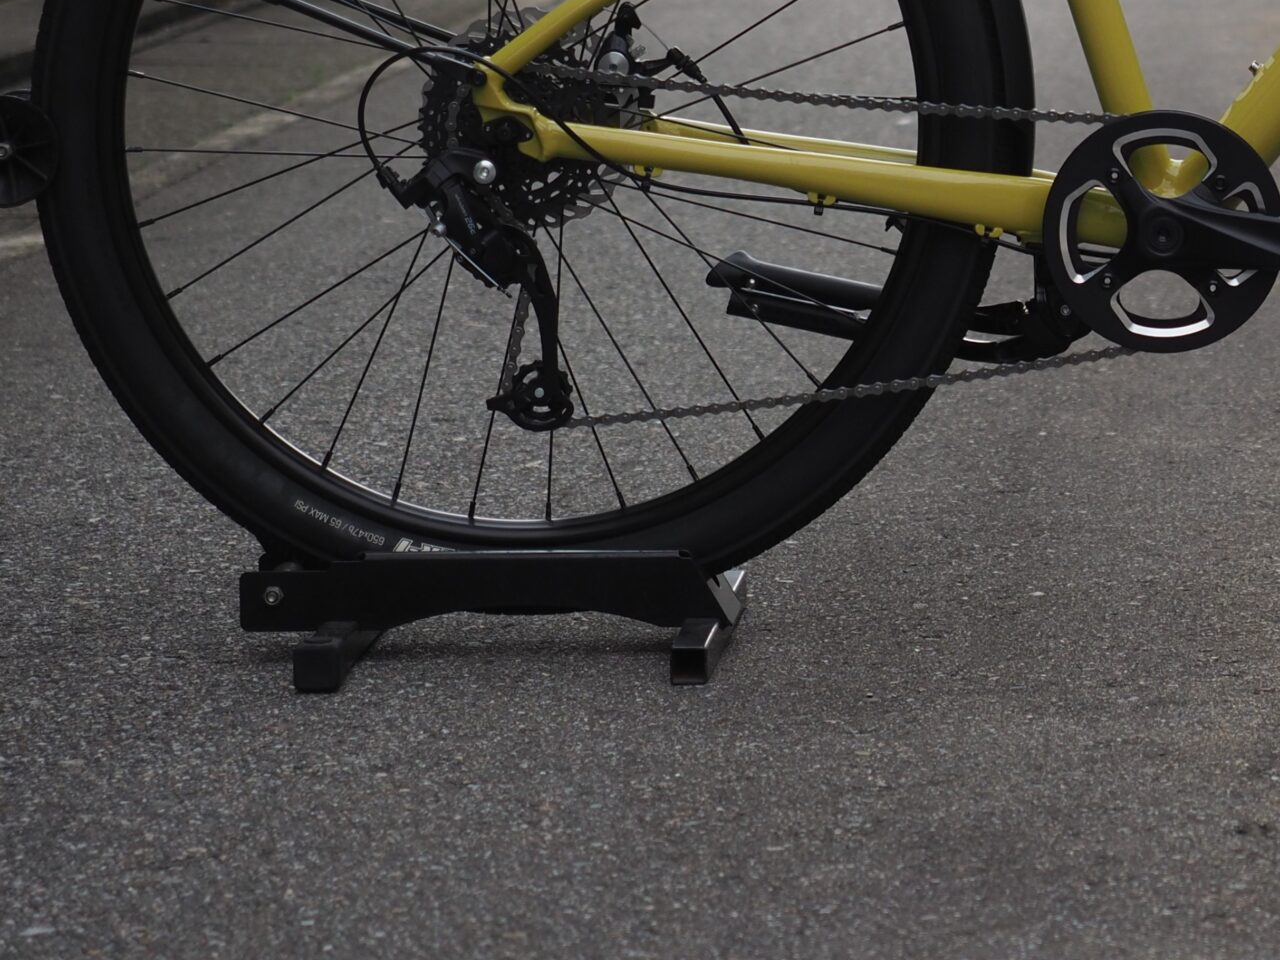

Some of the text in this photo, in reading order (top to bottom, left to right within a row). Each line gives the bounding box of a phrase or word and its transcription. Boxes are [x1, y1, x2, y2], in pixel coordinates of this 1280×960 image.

[294, 499, 309, 513] PSI
[309, 507, 329, 523] MAX
[329, 517, 342, 529] 65
[348, 525, 385, 546] 650x47b
